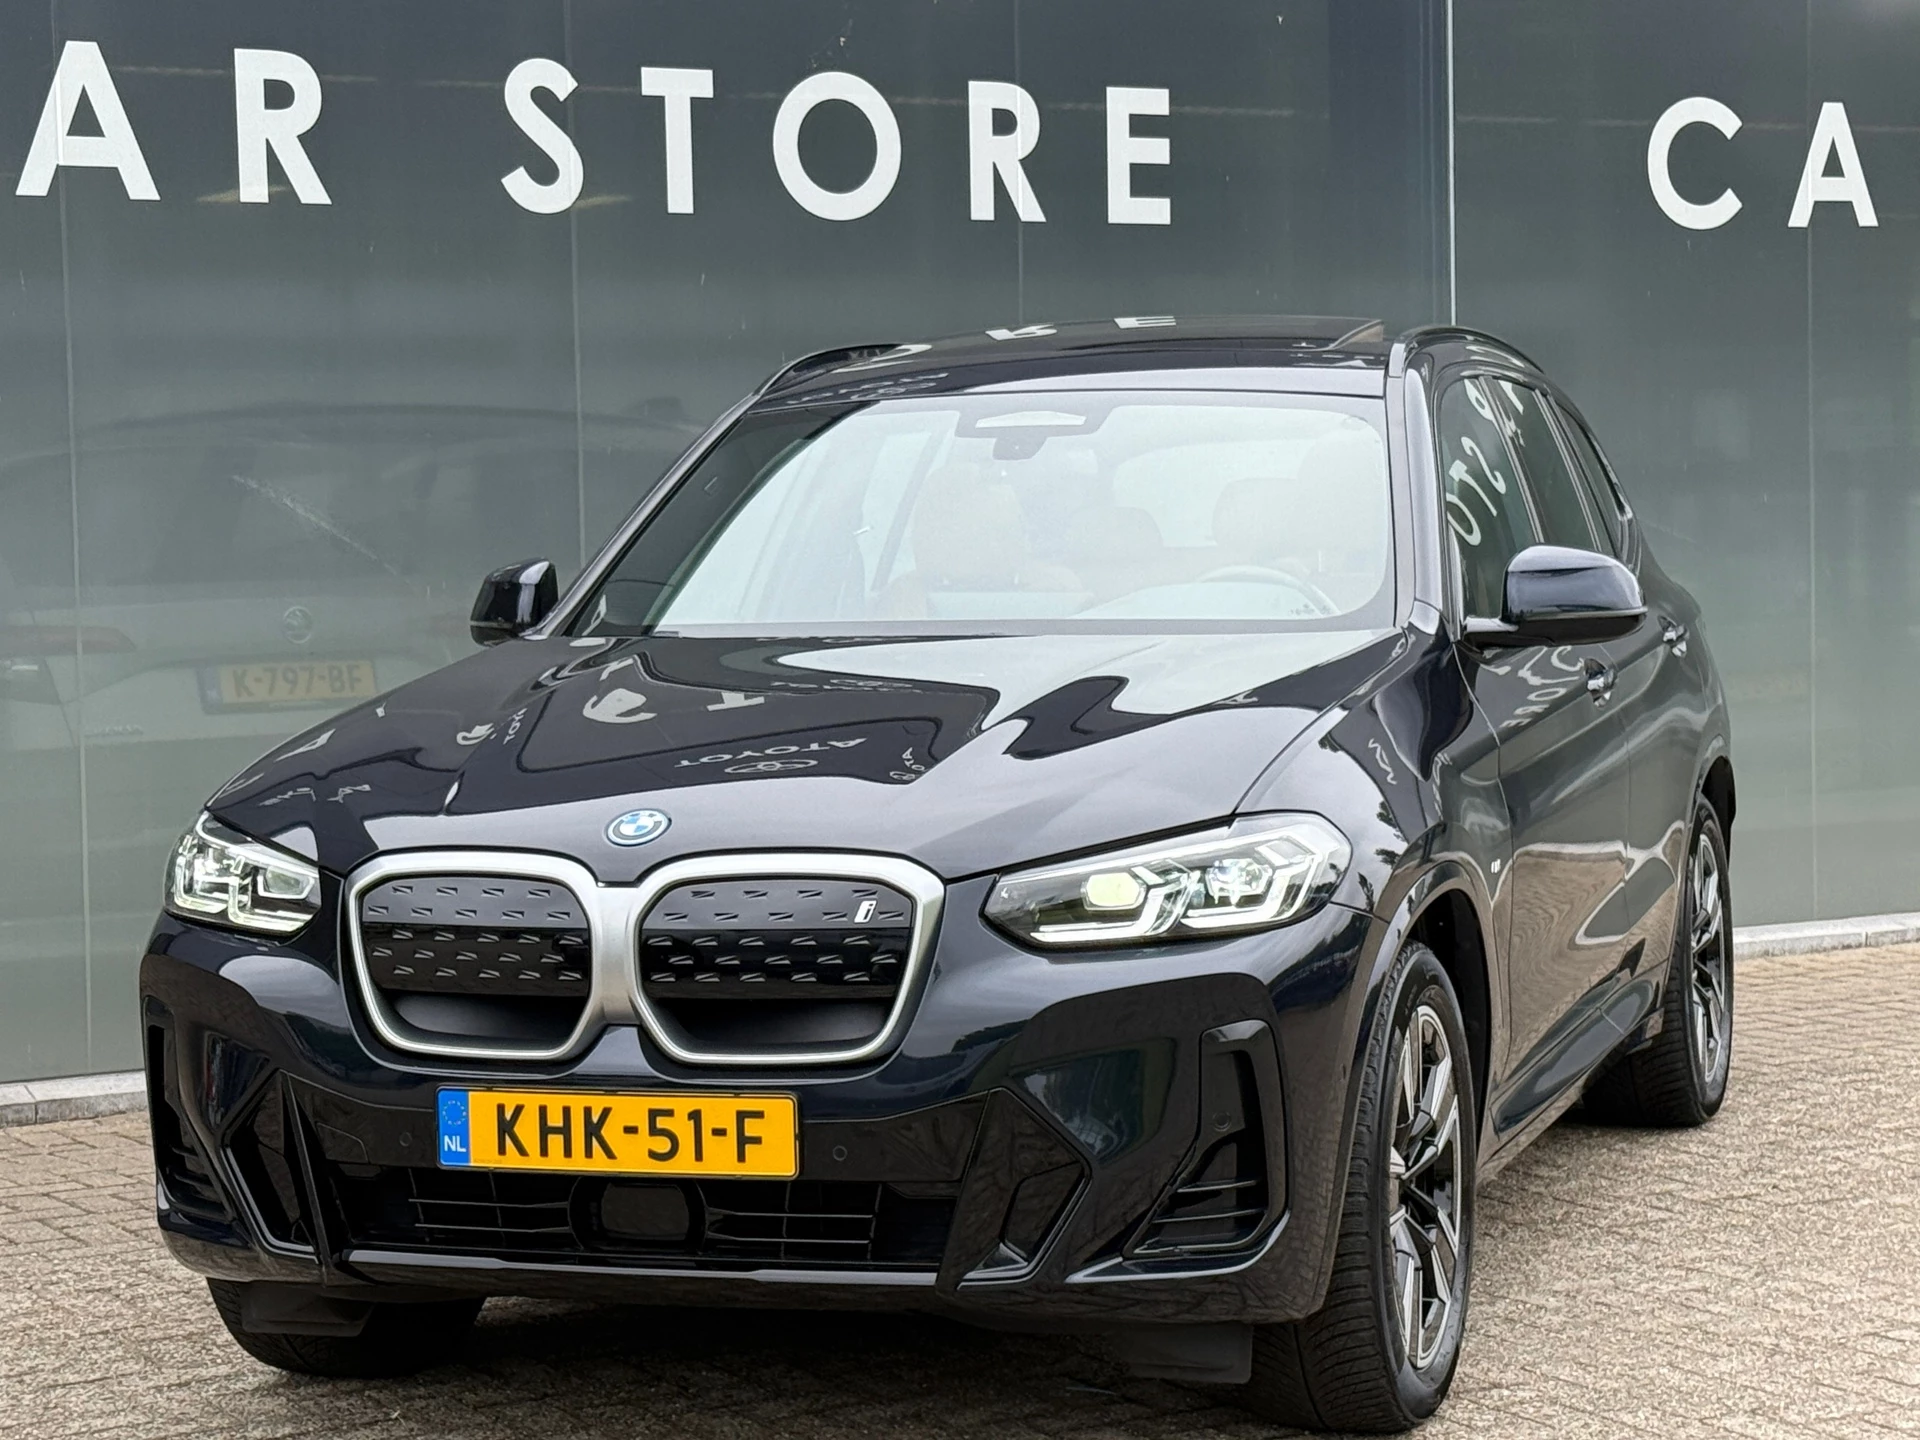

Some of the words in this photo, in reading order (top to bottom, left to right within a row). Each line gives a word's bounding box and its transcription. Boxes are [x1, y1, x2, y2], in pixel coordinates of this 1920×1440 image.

[15, 40, 332, 205] AR
[501, 57, 1172, 225] STORE
[1647, 96, 1880, 230] CA
[232, 664, 364, 698] K-797-BF
[443, 1134, 467, 1153] NL
[496, 1103, 766, 1163] KHK-51-F
